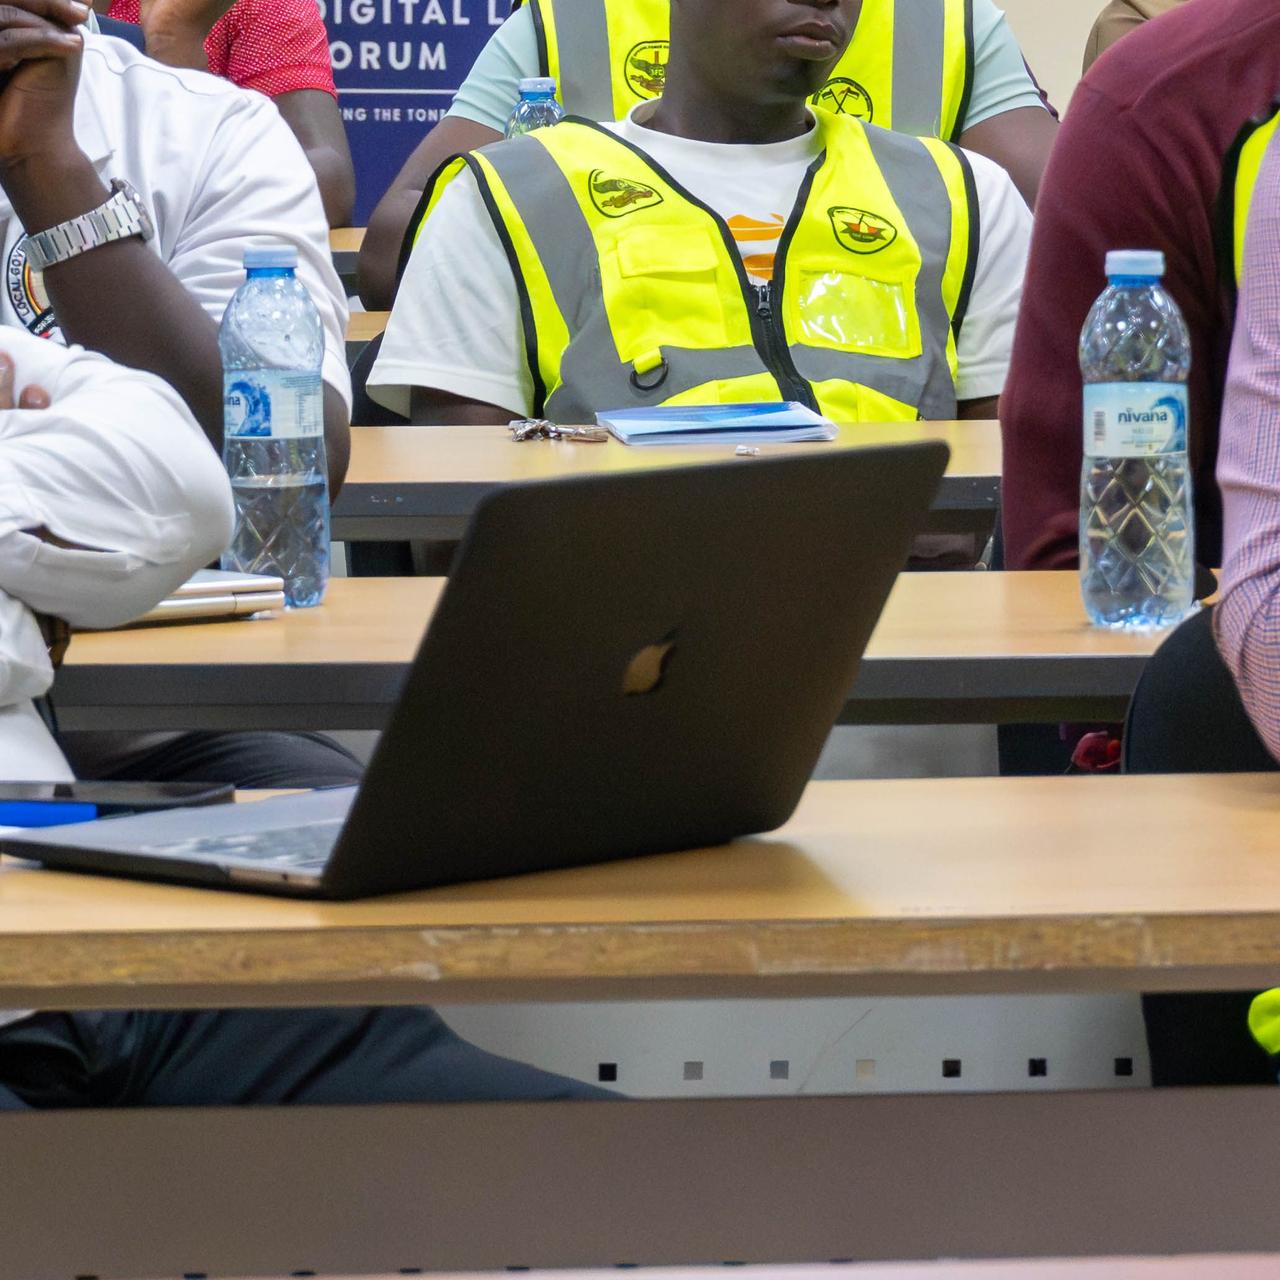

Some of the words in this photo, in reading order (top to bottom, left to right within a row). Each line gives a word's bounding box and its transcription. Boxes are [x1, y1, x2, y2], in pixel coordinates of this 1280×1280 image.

[339, 107, 368, 122] NG
[373, 107, 401, 121] THE
[1118, 407, 1169, 423] nivana
